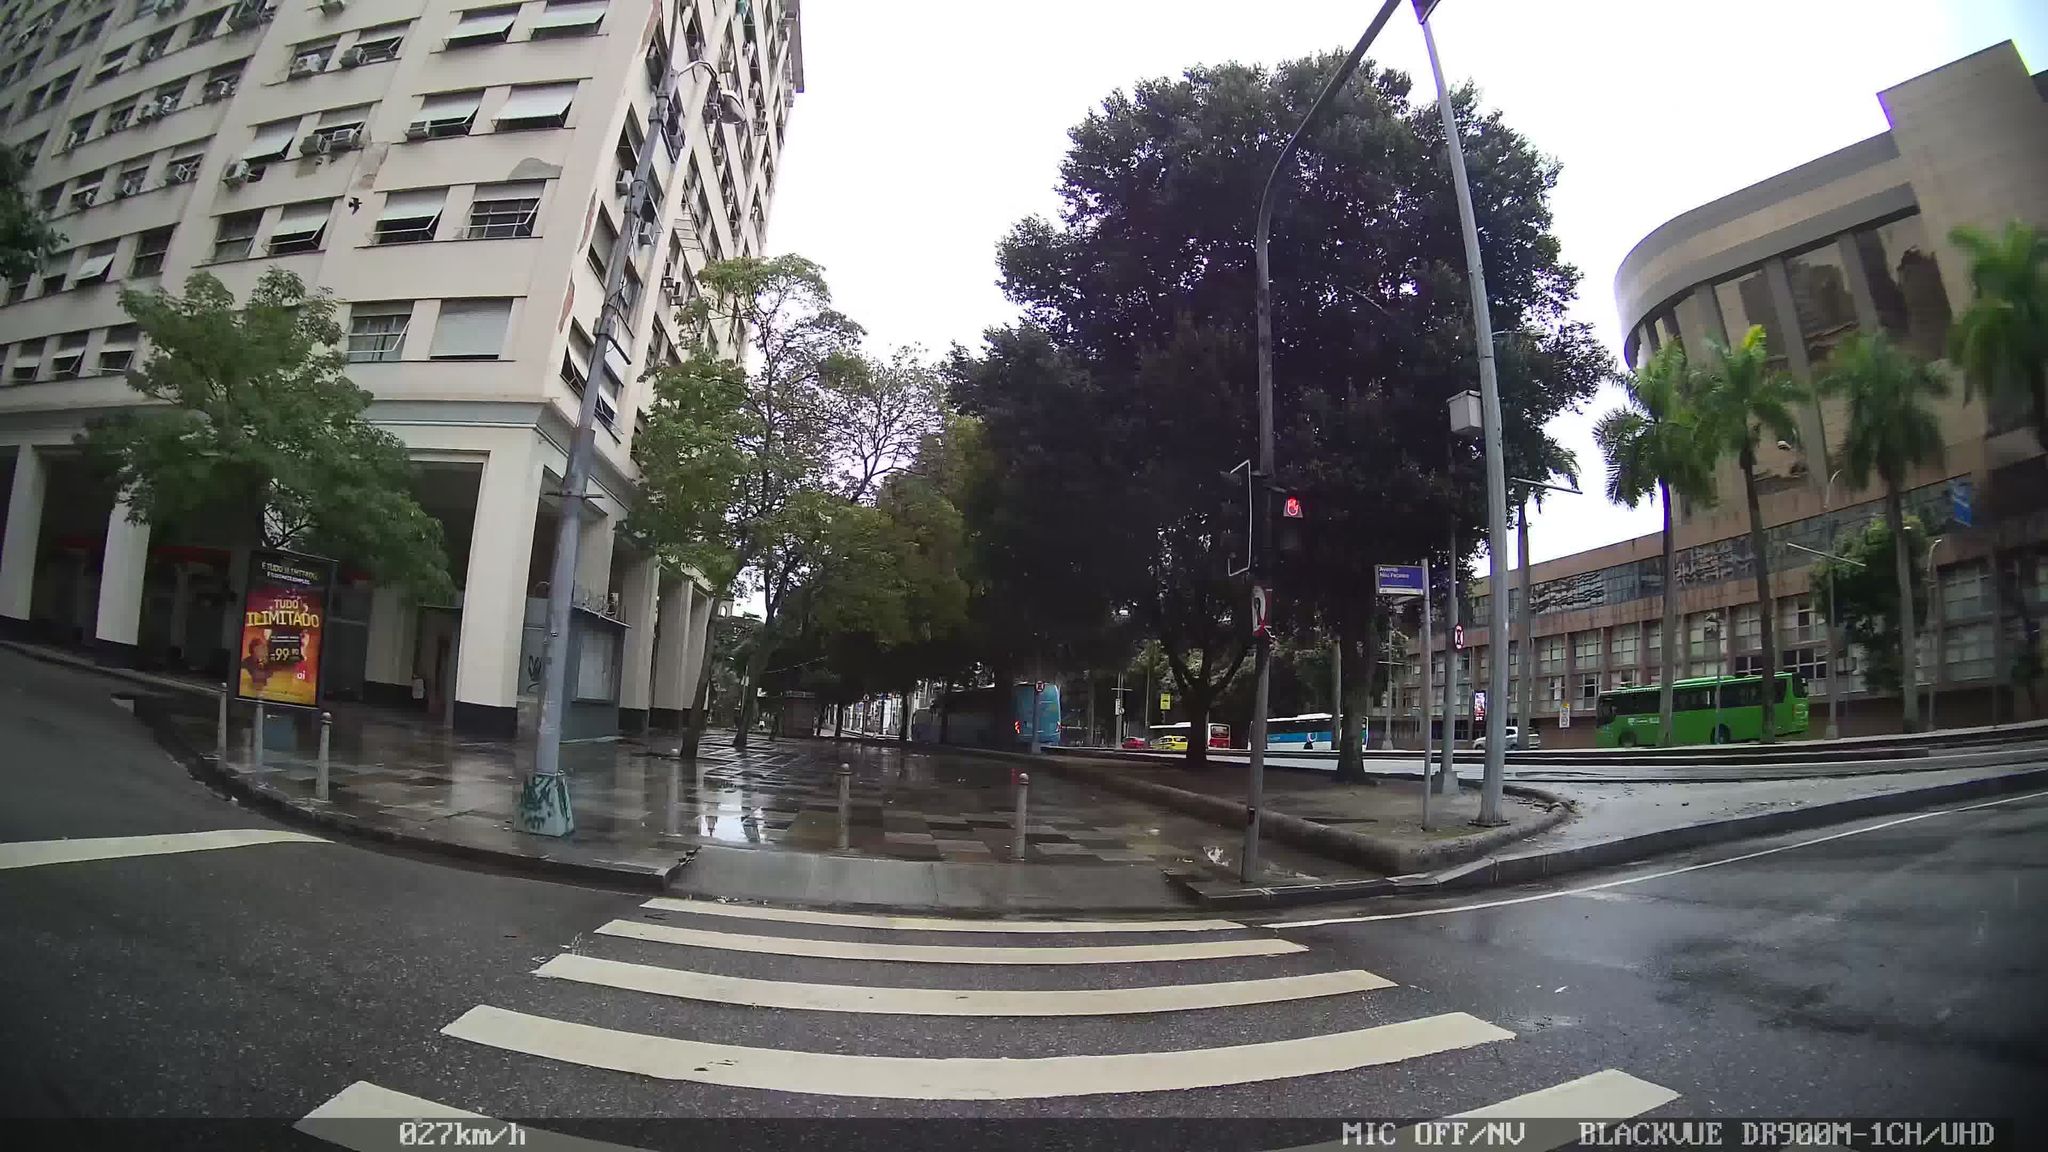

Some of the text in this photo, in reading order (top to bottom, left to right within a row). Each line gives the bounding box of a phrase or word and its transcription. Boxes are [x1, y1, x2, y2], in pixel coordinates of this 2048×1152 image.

[274, 599, 299, 609] TUDO
[246, 610, 320, 627] ILIMITADO
[297, 670, 306, 680] oi
